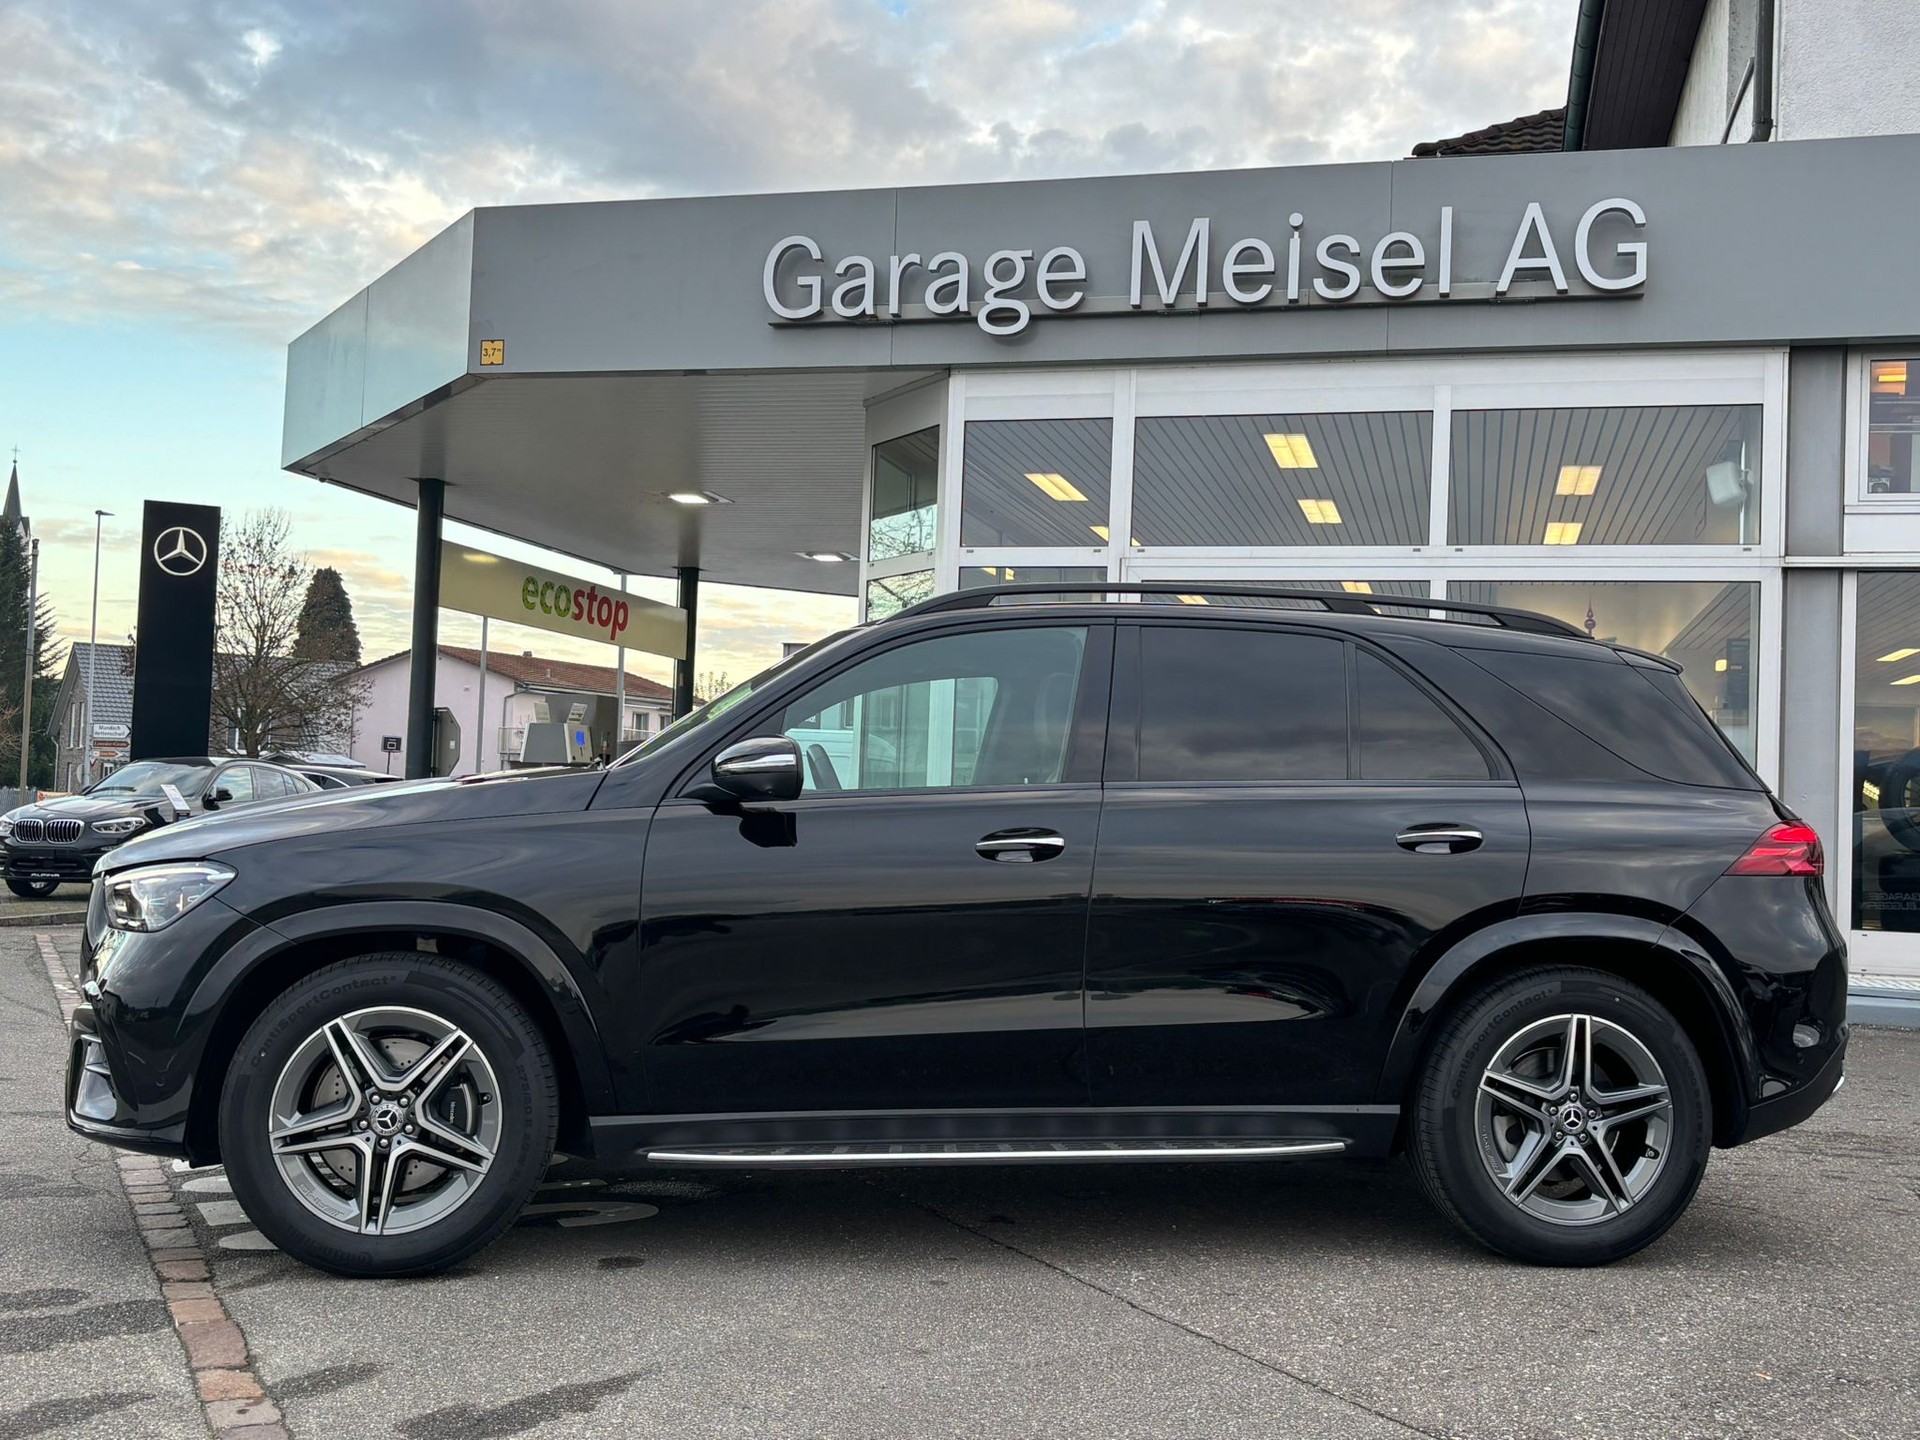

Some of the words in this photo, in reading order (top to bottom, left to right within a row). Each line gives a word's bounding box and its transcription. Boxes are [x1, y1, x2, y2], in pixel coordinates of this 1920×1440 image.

[763, 235, 1087, 335] Garage
[1130, 206, 1453, 309] Meisel
[1496, 197, 1648, 295] AG
[522, 576, 629, 640] ecostop
